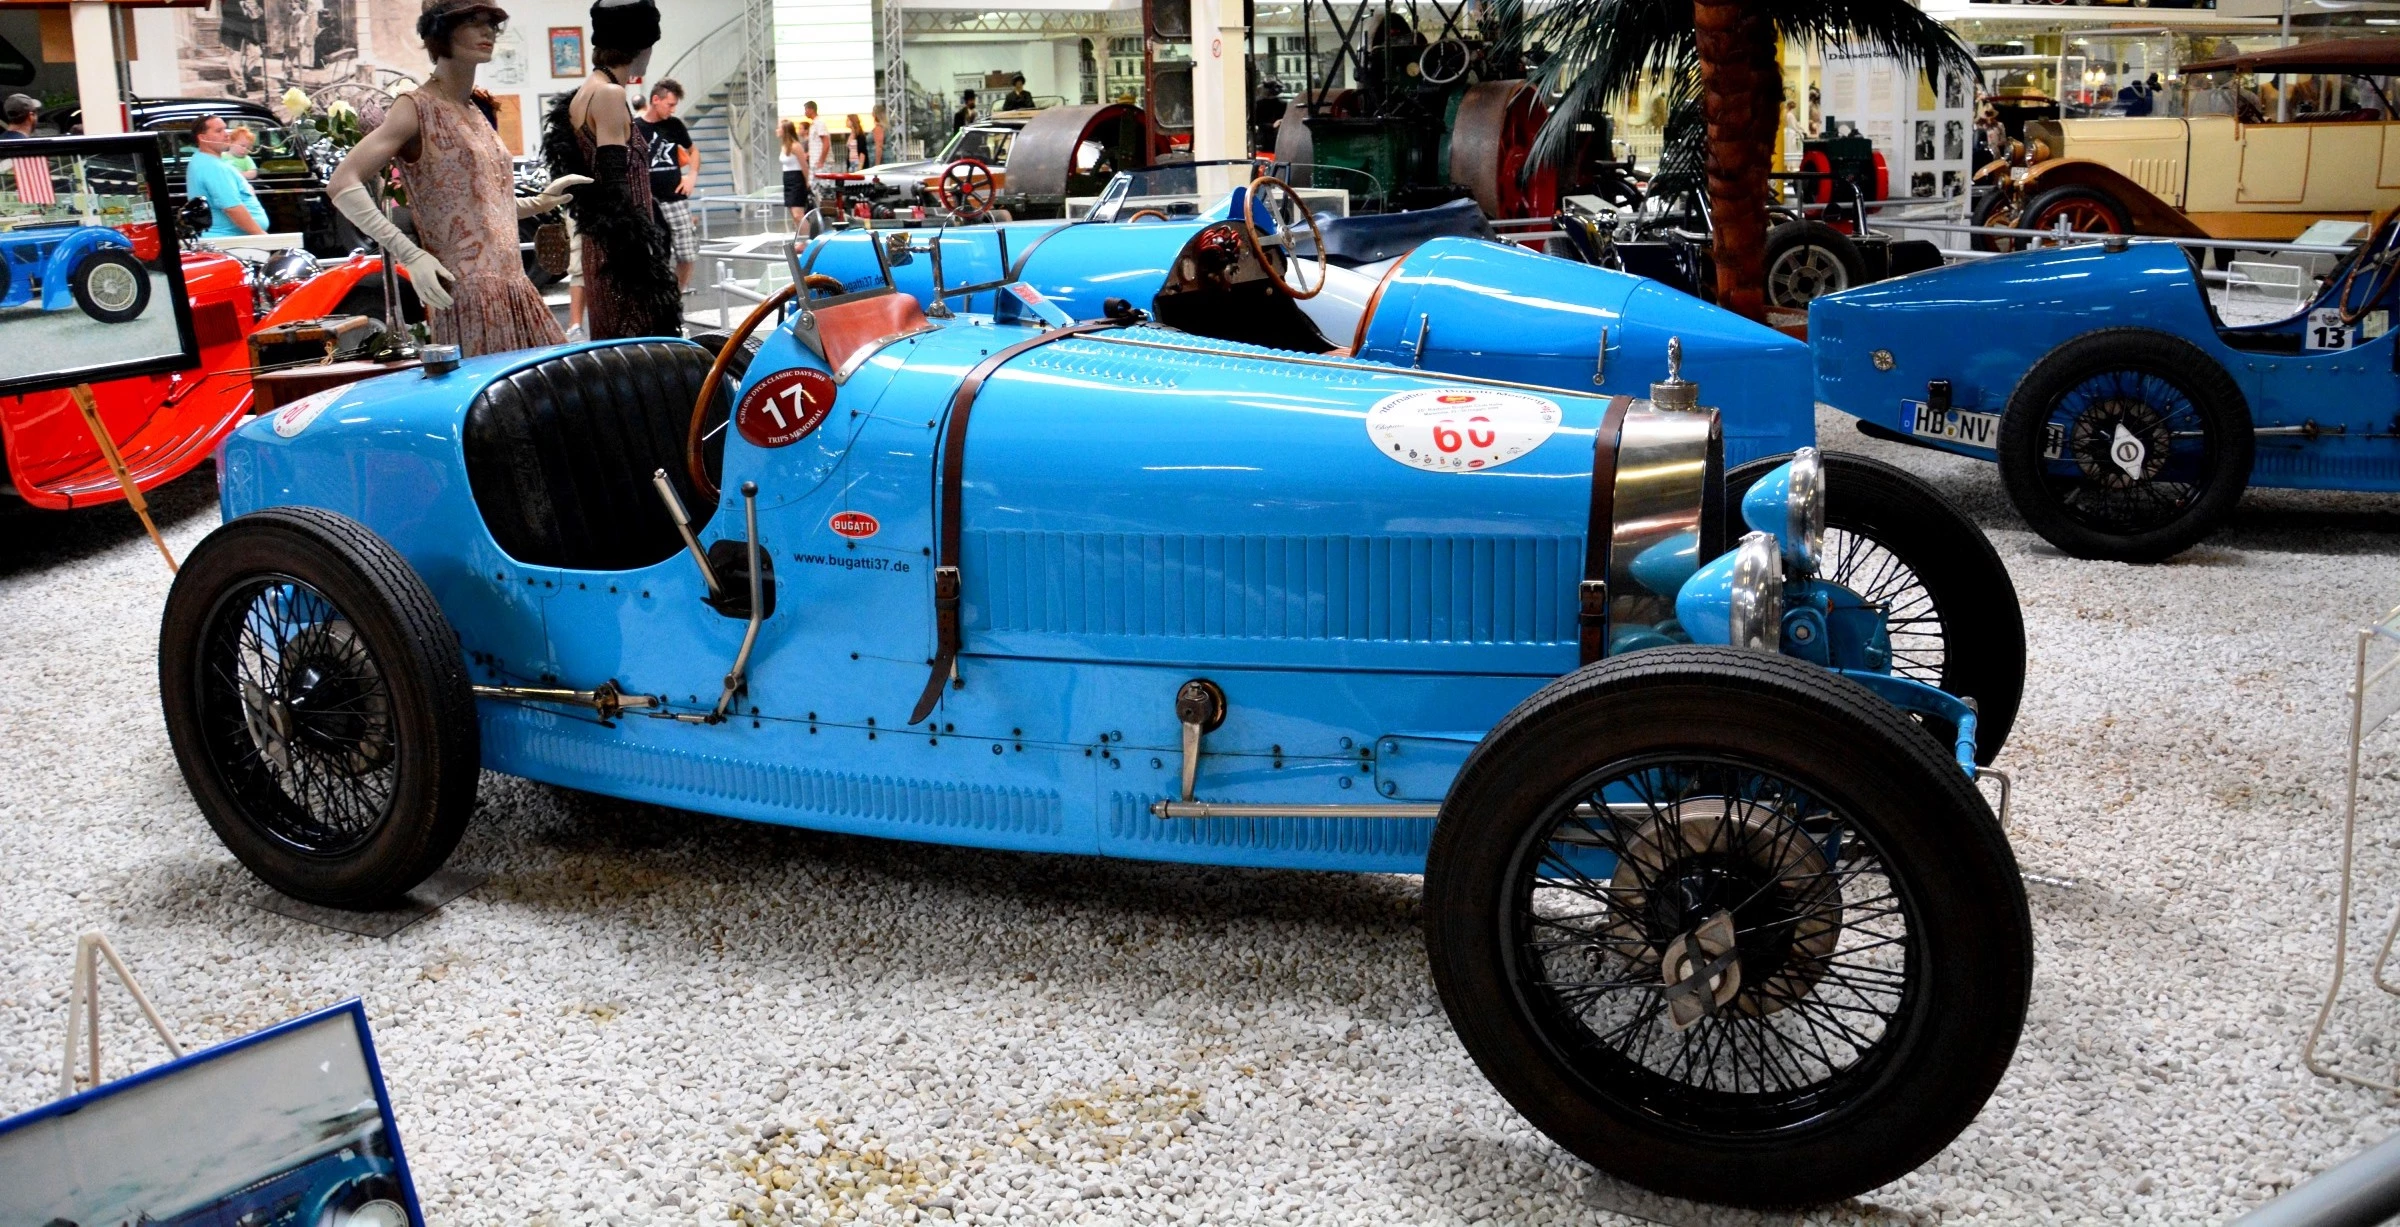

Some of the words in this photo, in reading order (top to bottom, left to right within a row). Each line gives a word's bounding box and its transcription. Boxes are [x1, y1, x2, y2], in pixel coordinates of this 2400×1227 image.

[2313, 326, 2345, 348] 13
[740, 395, 753, 424] SCHLOSS
[751, 382, 768, 397] DYCK
[767, 370, 794, 385] CLASSIC
[761, 382, 805, 429] 17
[768, 434, 789, 444] TRIPS
[789, 408, 824, 440] MEMORIAL
[1433, 416, 1496, 453] 60
[1960, 415, 1991, 442] NV
[834, 520, 874, 532] BUGATTI
[793, 552, 910, 573] www.bugatti37.de
